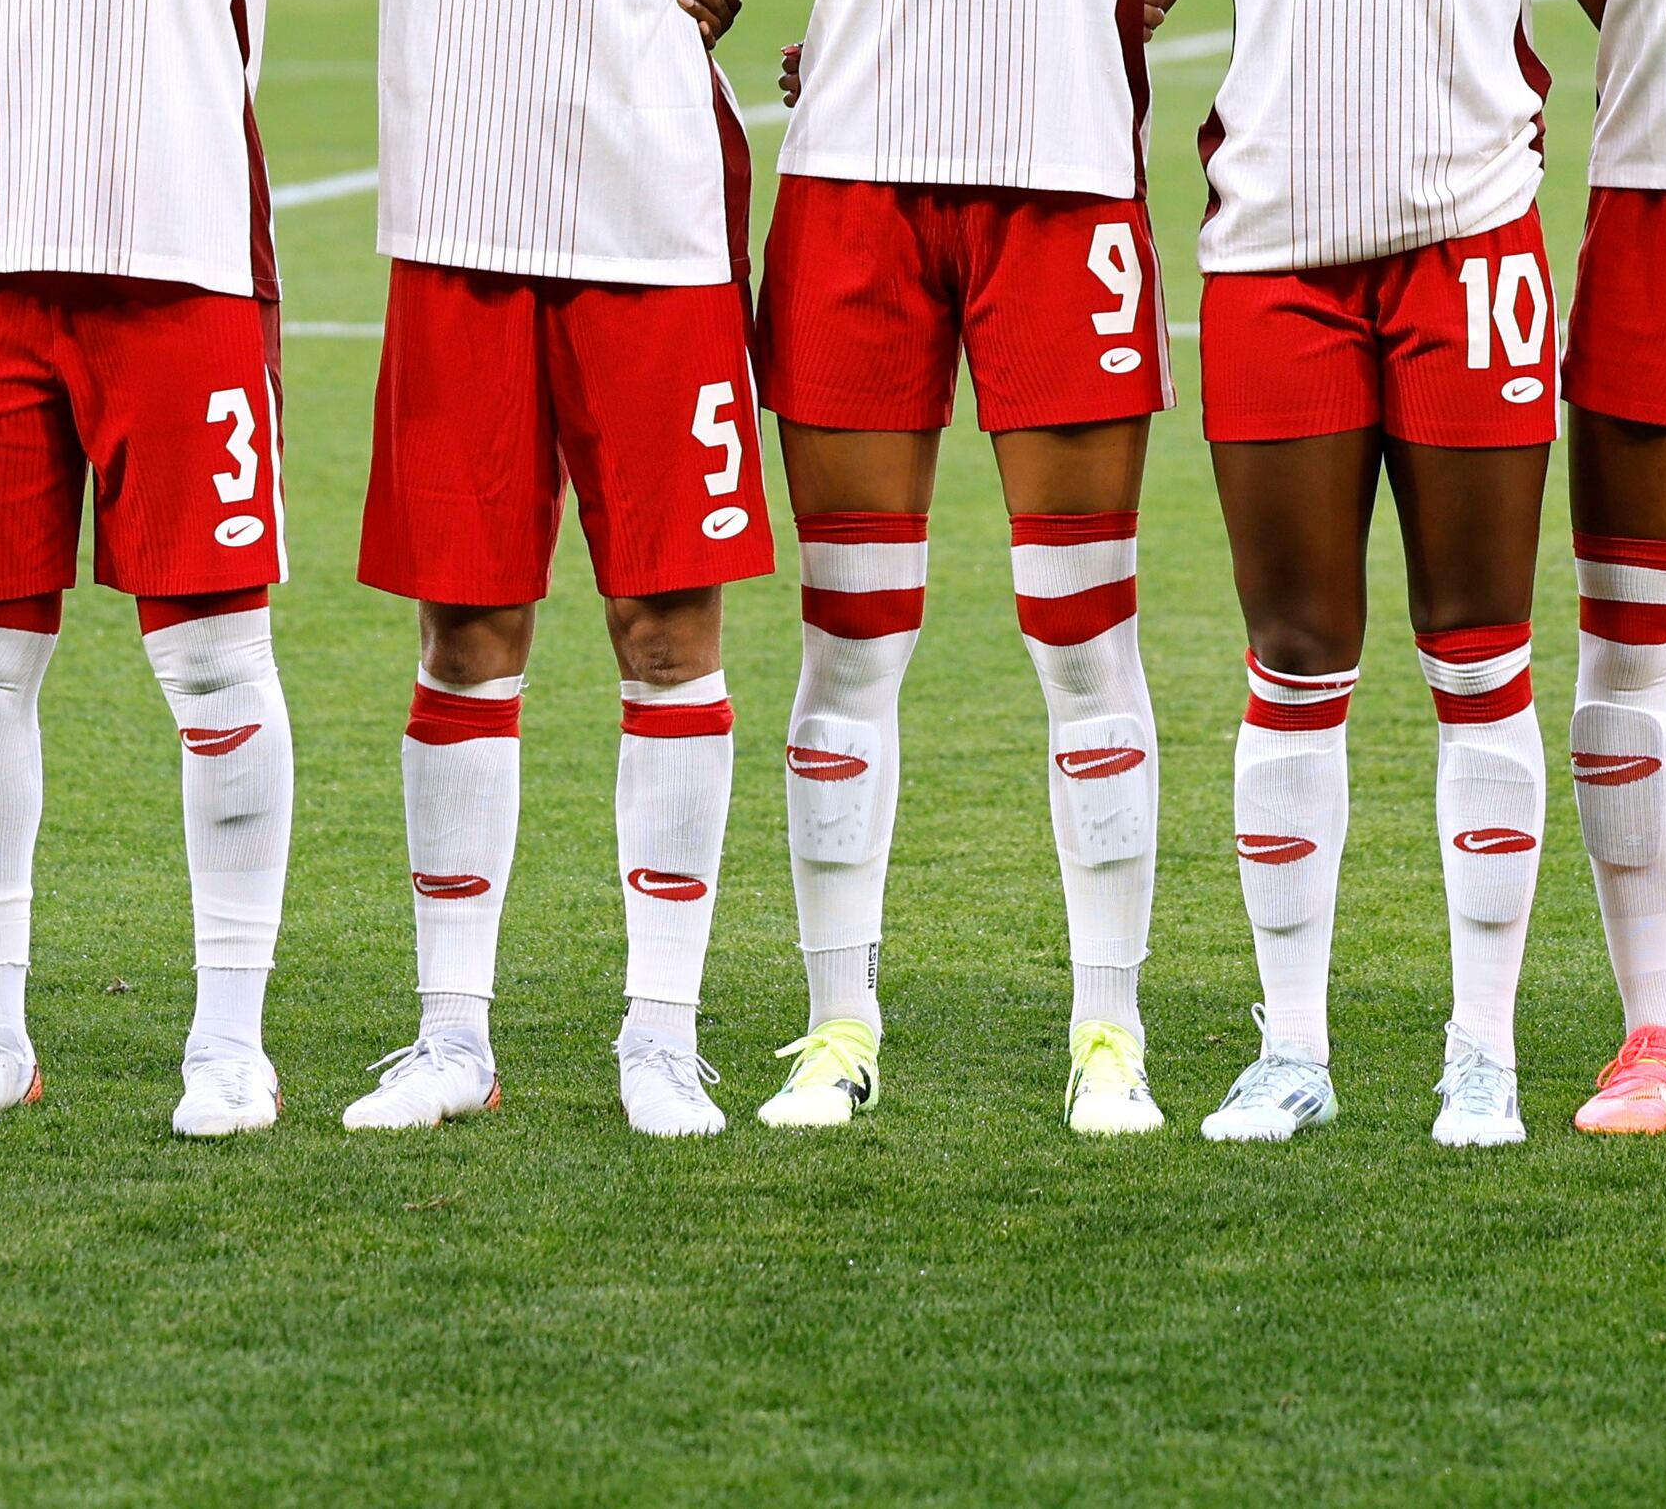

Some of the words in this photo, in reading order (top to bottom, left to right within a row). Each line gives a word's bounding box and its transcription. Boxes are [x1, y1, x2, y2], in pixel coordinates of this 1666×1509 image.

[1087, 222, 1143, 335] 9
[1458, 252, 1548, 370] 10
[205, 387, 259, 503] 3
[691, 381, 743, 497] 5
